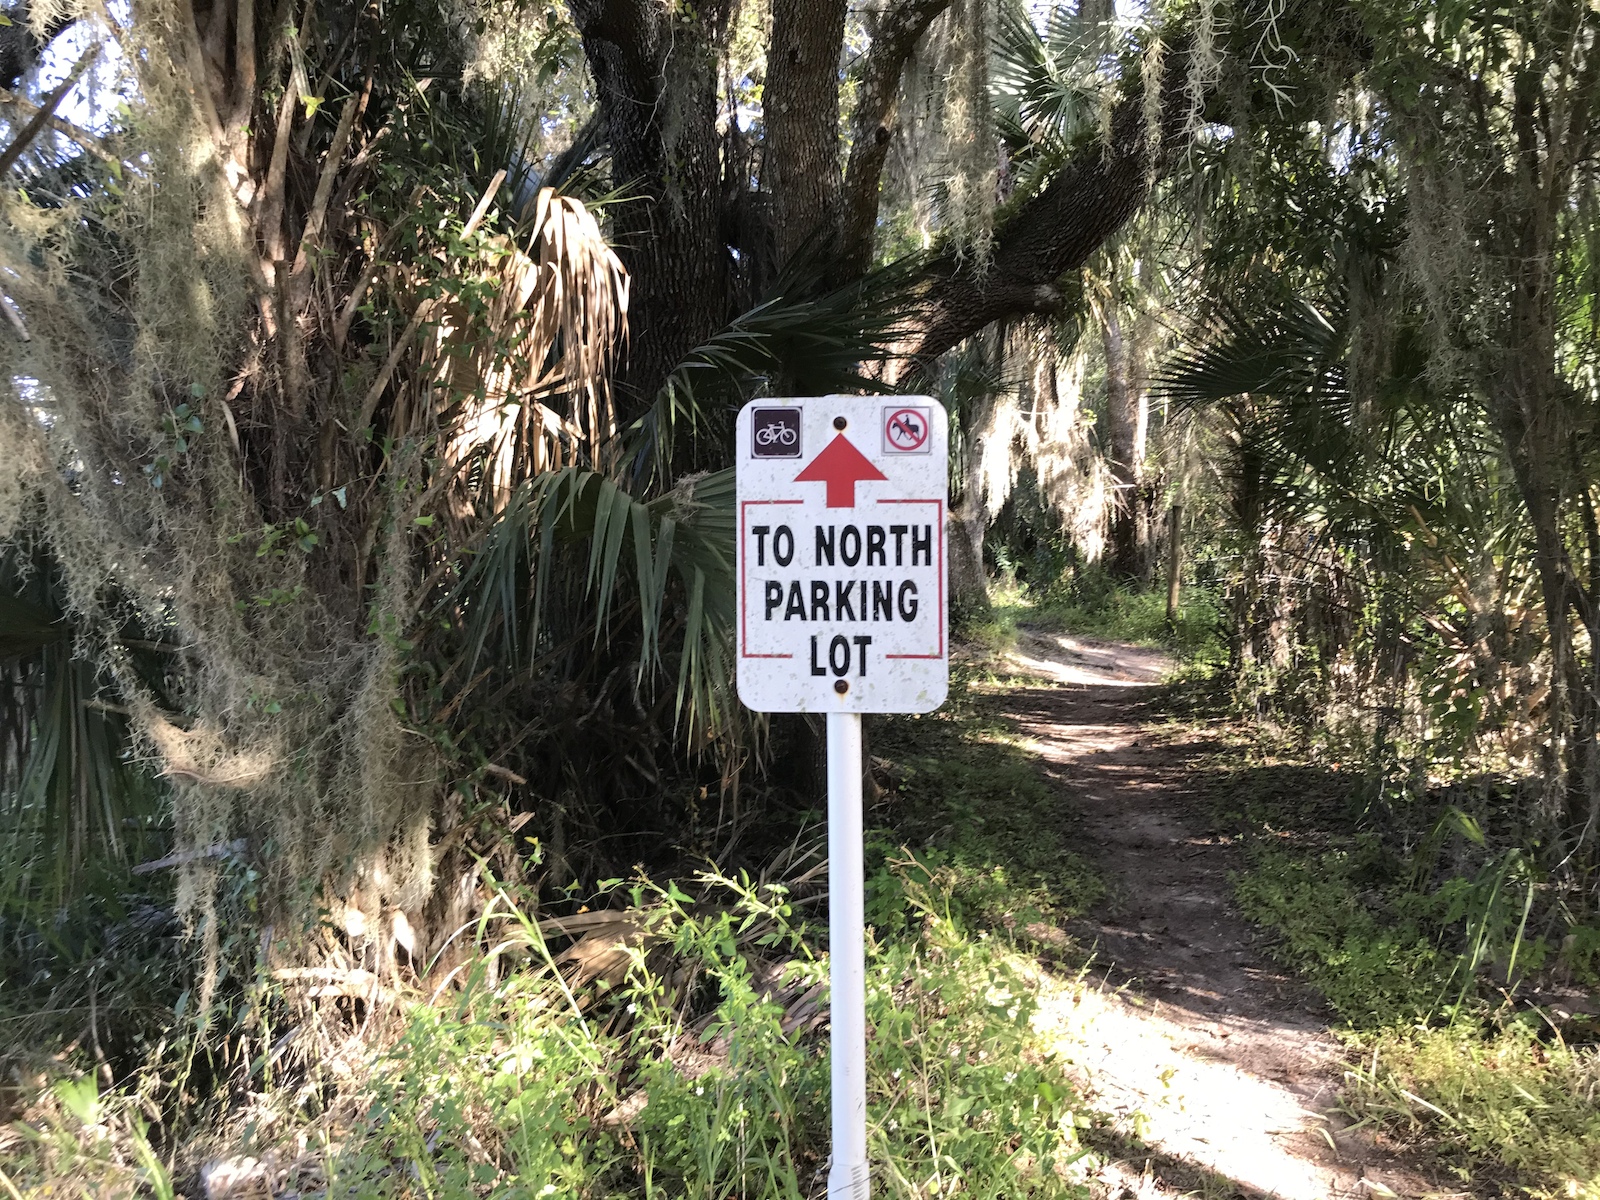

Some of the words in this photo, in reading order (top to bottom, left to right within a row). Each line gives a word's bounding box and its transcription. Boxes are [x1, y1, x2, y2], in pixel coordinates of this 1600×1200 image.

[752, 525, 795, 567] TO
[815, 525, 932, 567] NORTH
[765, 580, 919, 622] PARKING
[811, 635, 872, 677] LOT
